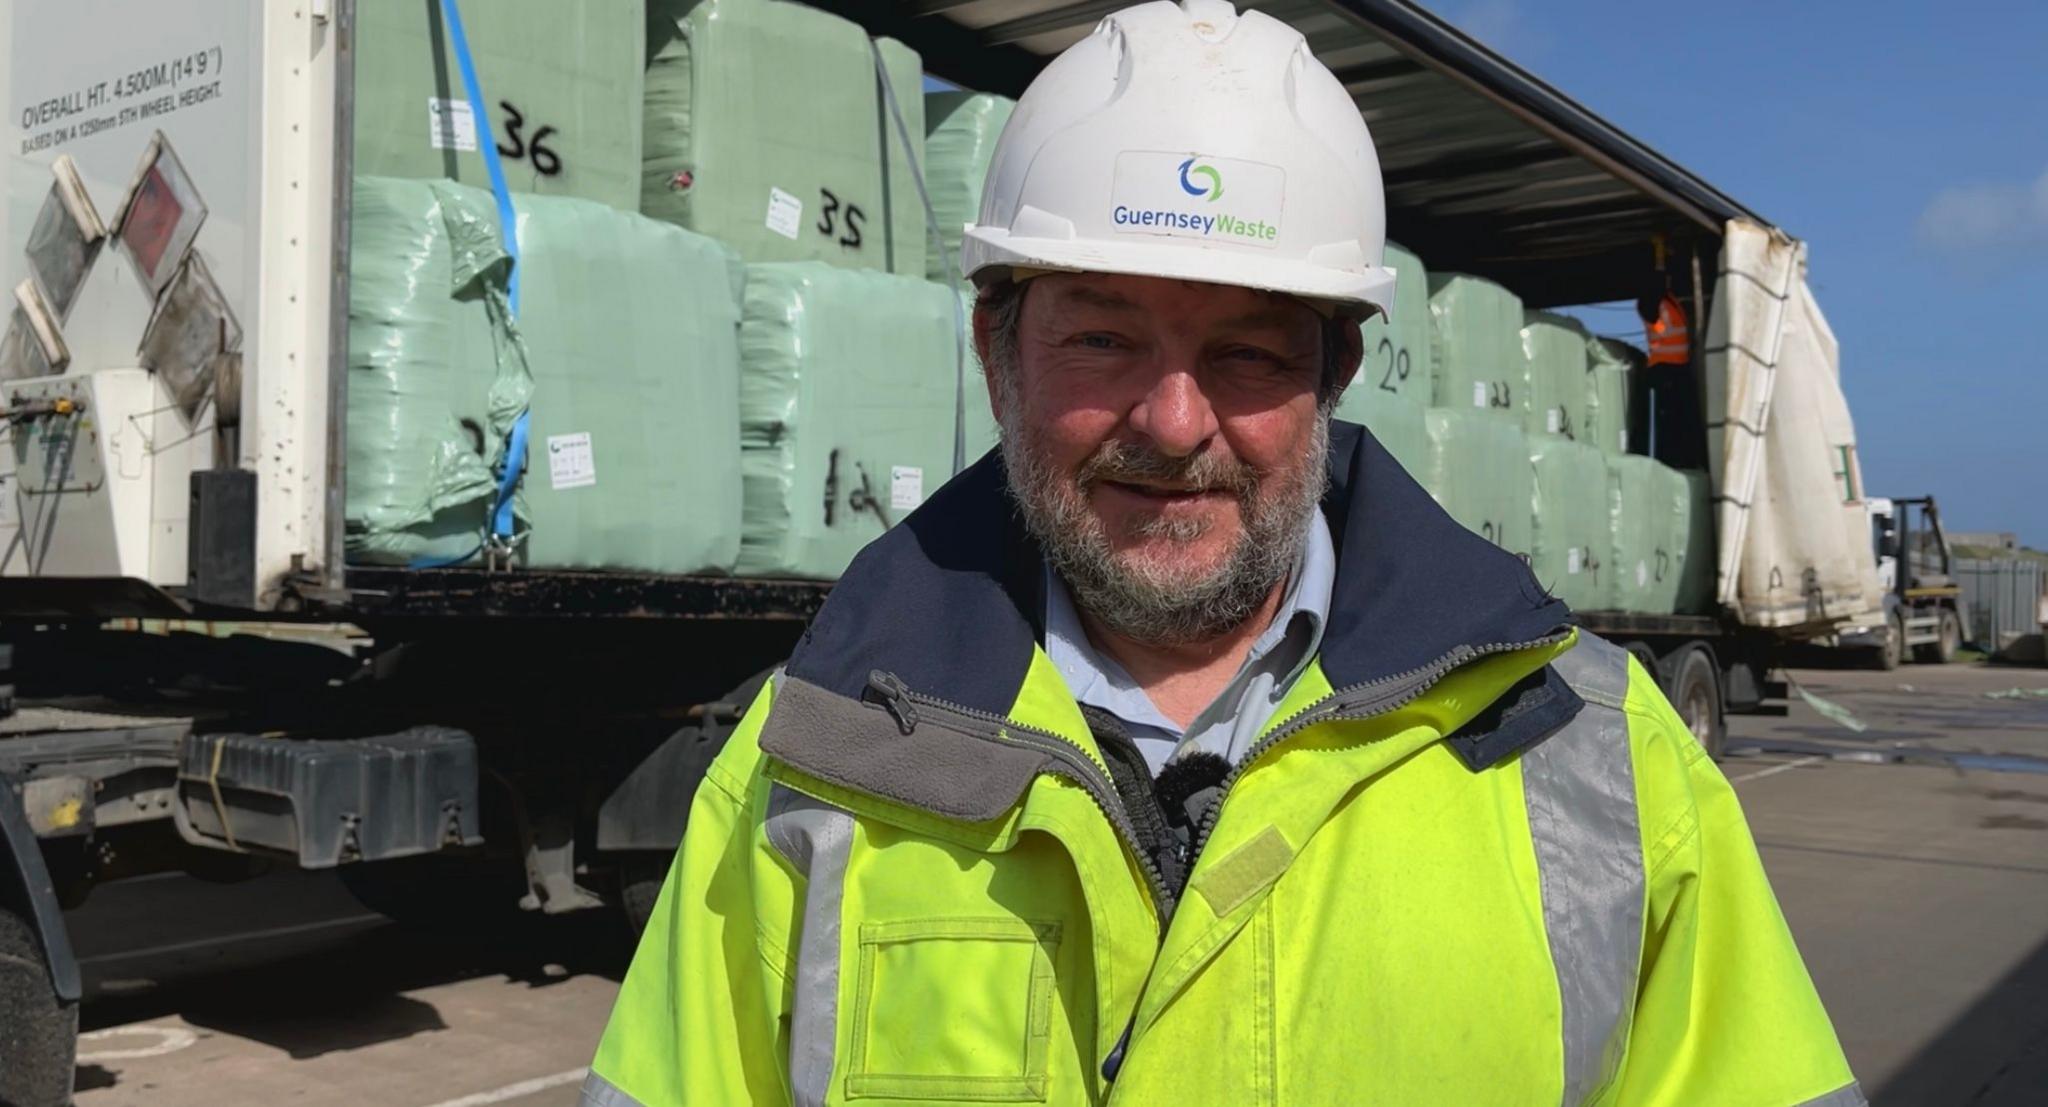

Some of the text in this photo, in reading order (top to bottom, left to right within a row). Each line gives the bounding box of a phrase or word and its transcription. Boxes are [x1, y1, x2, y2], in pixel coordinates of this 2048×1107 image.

[21, 132, 52, 155] BASED
[54, 128, 68, 146] ON
[70, 125, 77, 139] A
[140, 95, 176, 120] WHEEL
[22, 92, 84, 129] OVERALL
[87, 82, 111, 108] HT.
[496, 100, 563, 176] 36
[816, 187, 867, 250] 35
[1378, 337, 1410, 394] 20
